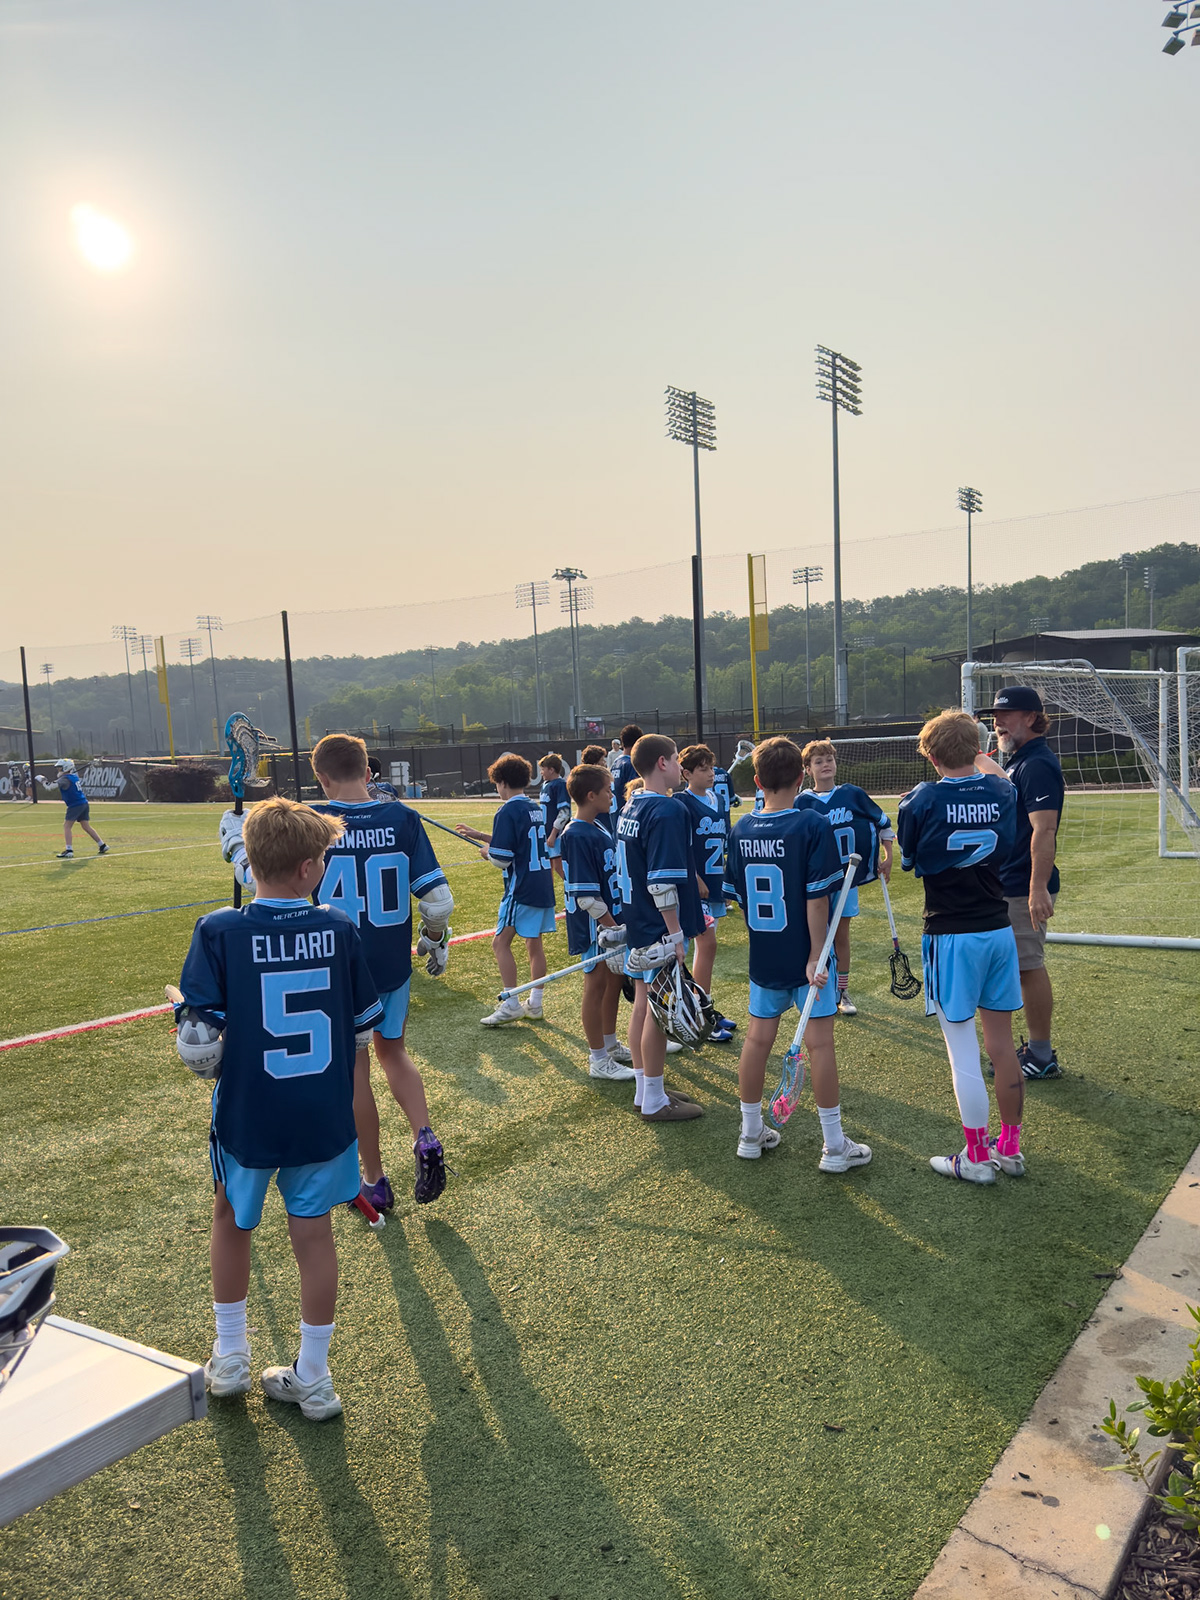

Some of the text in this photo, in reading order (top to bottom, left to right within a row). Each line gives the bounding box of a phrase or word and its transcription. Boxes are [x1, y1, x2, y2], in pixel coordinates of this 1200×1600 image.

[80, 767, 119, 787] ARROW
[946, 803, 1000, 824] HARRIS
[329, 827, 396, 849] DWARDS
[739, 839, 785, 858] FRANKS
[317, 851, 411, 928] 40
[745, 863, 788, 932] 8
[272, 910, 309, 921] MERCURY
[251, 929, 336, 963] ELLARD
[260, 967, 332, 1080] 5
